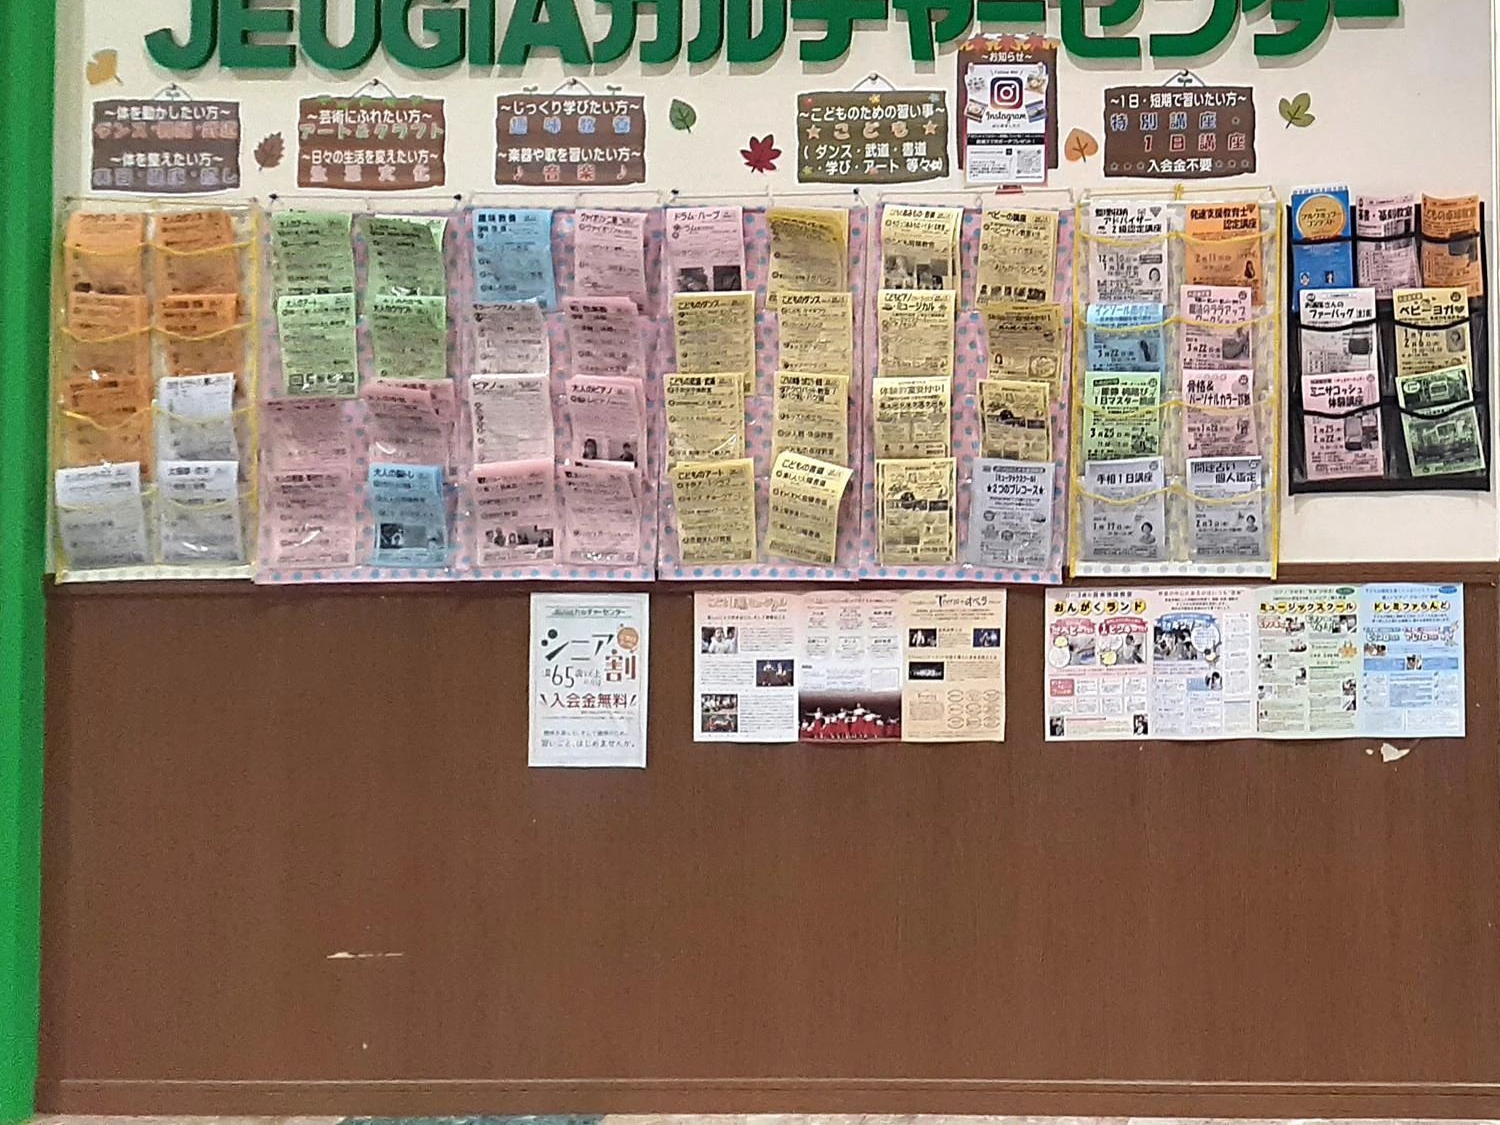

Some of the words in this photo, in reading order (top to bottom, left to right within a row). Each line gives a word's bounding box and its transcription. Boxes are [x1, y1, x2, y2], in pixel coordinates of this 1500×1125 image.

[982, 52, 1032, 62] 〜お知らせ〜
[1110, 92, 1246, 108] 〜1日・短期で習いたい方〜
[500, 100, 640, 115] 〜じっくり学びたい方〜
[799, 104, 945, 120] 〜こどものための習い事〜
[307, 109, 432, 124] 〜芸術にふれたい方〜
[986, 111, 1026, 123] Instagram
[1110, 112, 1217, 130] 特別講座
[834, 122, 909, 139] こども
[1144, 133, 1245, 152] 1日講座
[302, 150, 438, 165] 〜日々の生活を変えたい方〜
[498, 147, 641, 162] 〜楽器や歌を習いたい方〜
[1147, 158, 1213, 173] 入会金不要
[1104, 217, 1152, 225] アドバイザー
[1191, 209, 1247, 220] 発達支援教育士
[1223, 219, 1257, 229] 認定講座
[678, 300, 720, 310] こどものダンス
[782, 295, 821, 305] こどものダンス
[1309, 309, 1354, 318] ファーバッグ
[1400, 304, 1454, 316] ベビーヨガ
[1187, 379, 1214, 394] 骨格&
[1310, 385, 1363, 397] ミニサコッシュ
[1329, 395, 1364, 407] 体験講座
[782, 459, 825, 474] こどもの書道
[1194, 462, 1236, 474] 開運占い
[678, 469, 724, 479] こどものアート
[1096, 472, 1153, 484] 手相1日講座
[1215, 472, 1256, 484] 個人鑑定
[1053, 600, 1147, 616] おんがくランド
[1259, 602, 1359, 614] ミュージックスクール
[1374, 601, 1450, 614] ドレミファらんど
[541, 629, 615, 661] シニア
[605, 654, 636, 682] 割
[550, 692, 627, 708] 入会金無料
